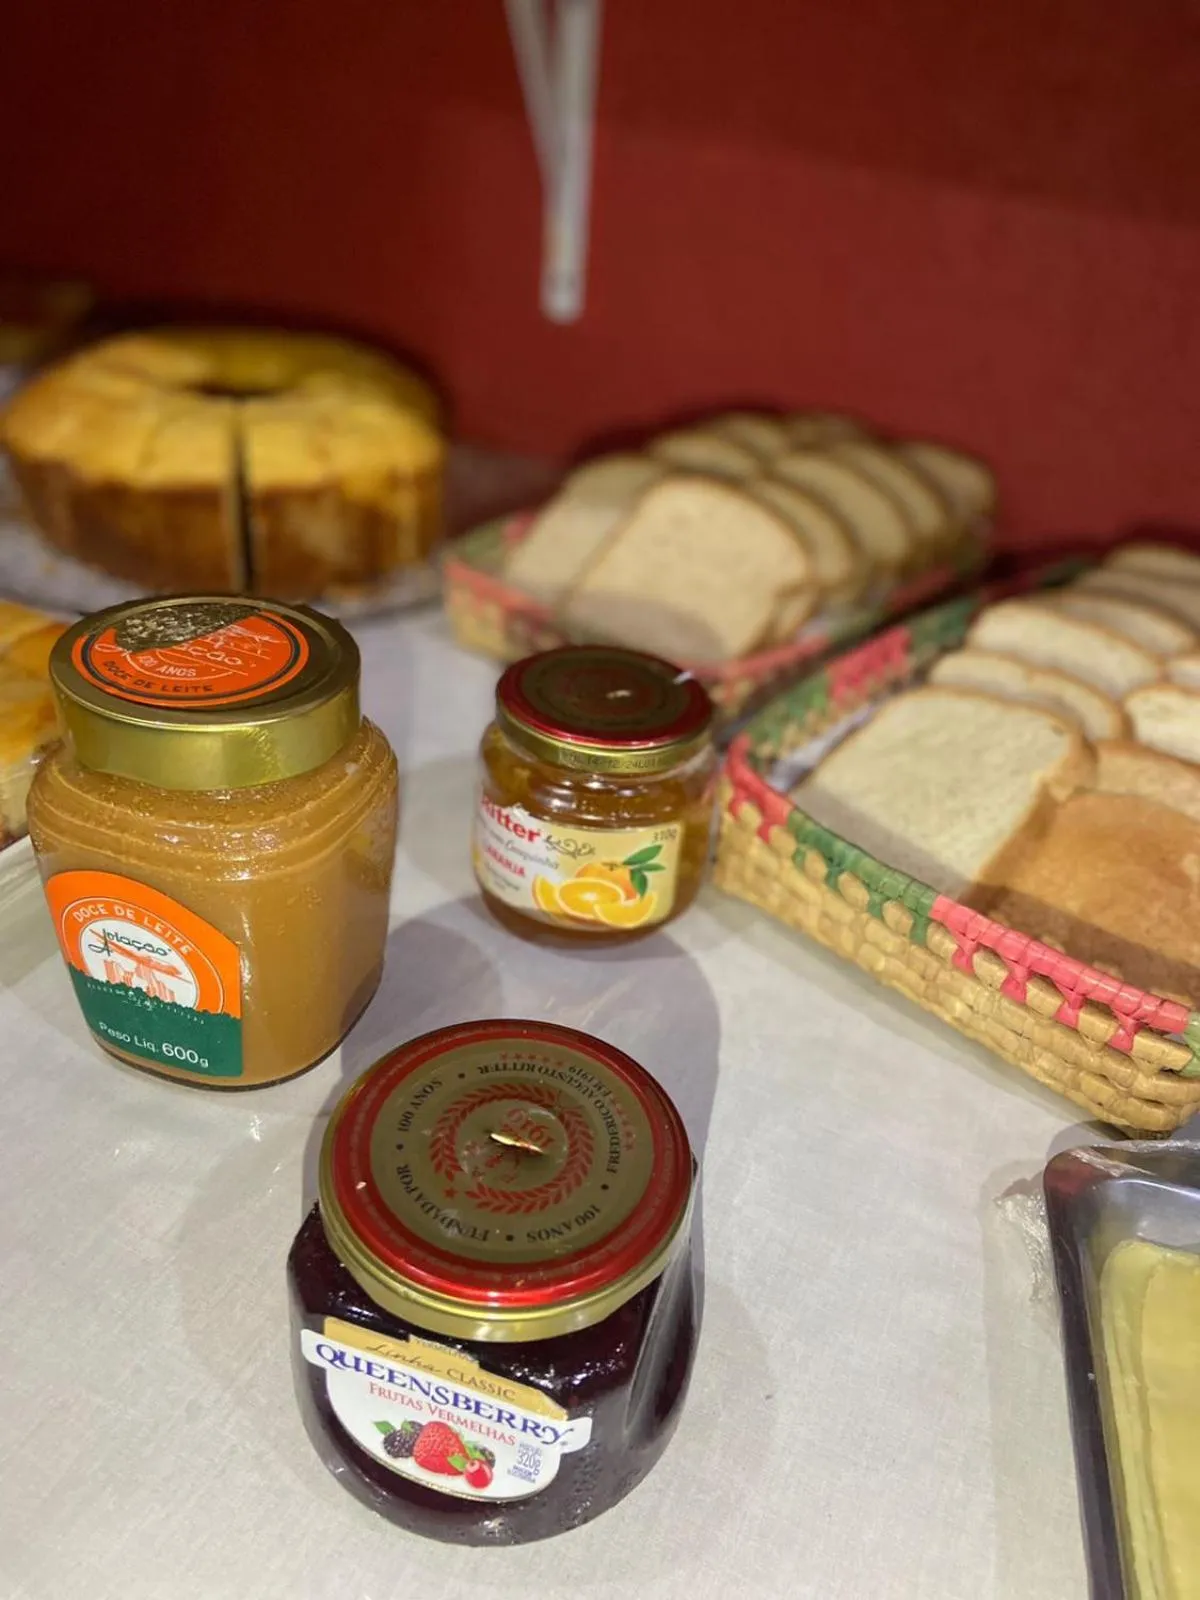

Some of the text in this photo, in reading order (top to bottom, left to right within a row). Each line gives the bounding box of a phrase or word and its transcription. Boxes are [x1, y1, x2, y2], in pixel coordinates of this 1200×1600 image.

[103, 660, 213, 693] DOCE DE LEITE
[73, 903, 193, 955] DOCE DE LEITE
[98, 1021, 131, 1043] Peso
[477, 1062, 535, 1076] RITTER
[397, 1078, 443, 1133] 100 ANOS
[396, 1163, 491, 1243] FUNDADA POR
[526, 1204, 601, 1244] 100 ANOS
[315, 1343, 575, 1446] QUEENSBERRY
[366, 1344, 442, 1373] Linha
[446, 1368, 517, 1401] CLASSIC
[369, 1381, 517, 1447] FRUTAS VERMELHAS
